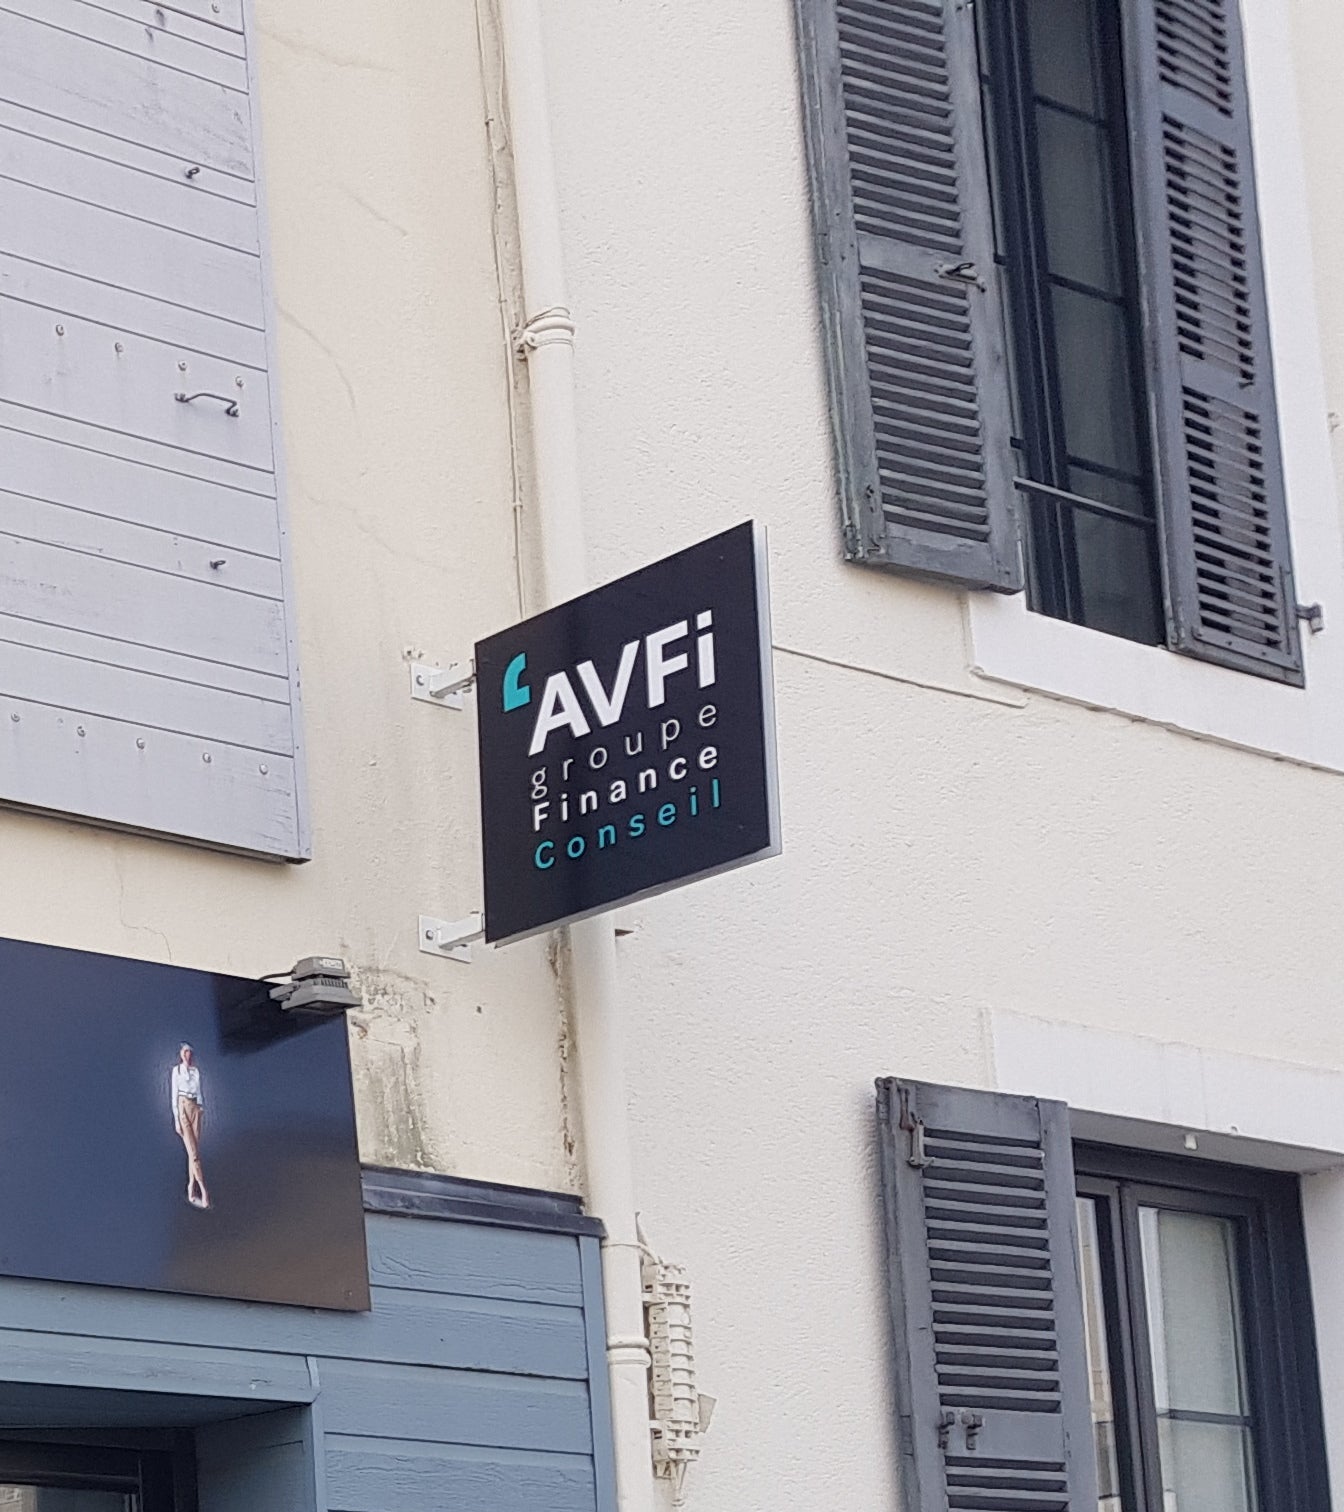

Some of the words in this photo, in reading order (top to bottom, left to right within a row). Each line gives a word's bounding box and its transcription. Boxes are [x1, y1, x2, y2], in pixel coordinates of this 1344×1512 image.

[527, 609, 716, 757] AVFi
[531, 704, 717, 798] groupe
[533, 744, 718, 832] Finance
[535, 779, 719, 869] Conseil
